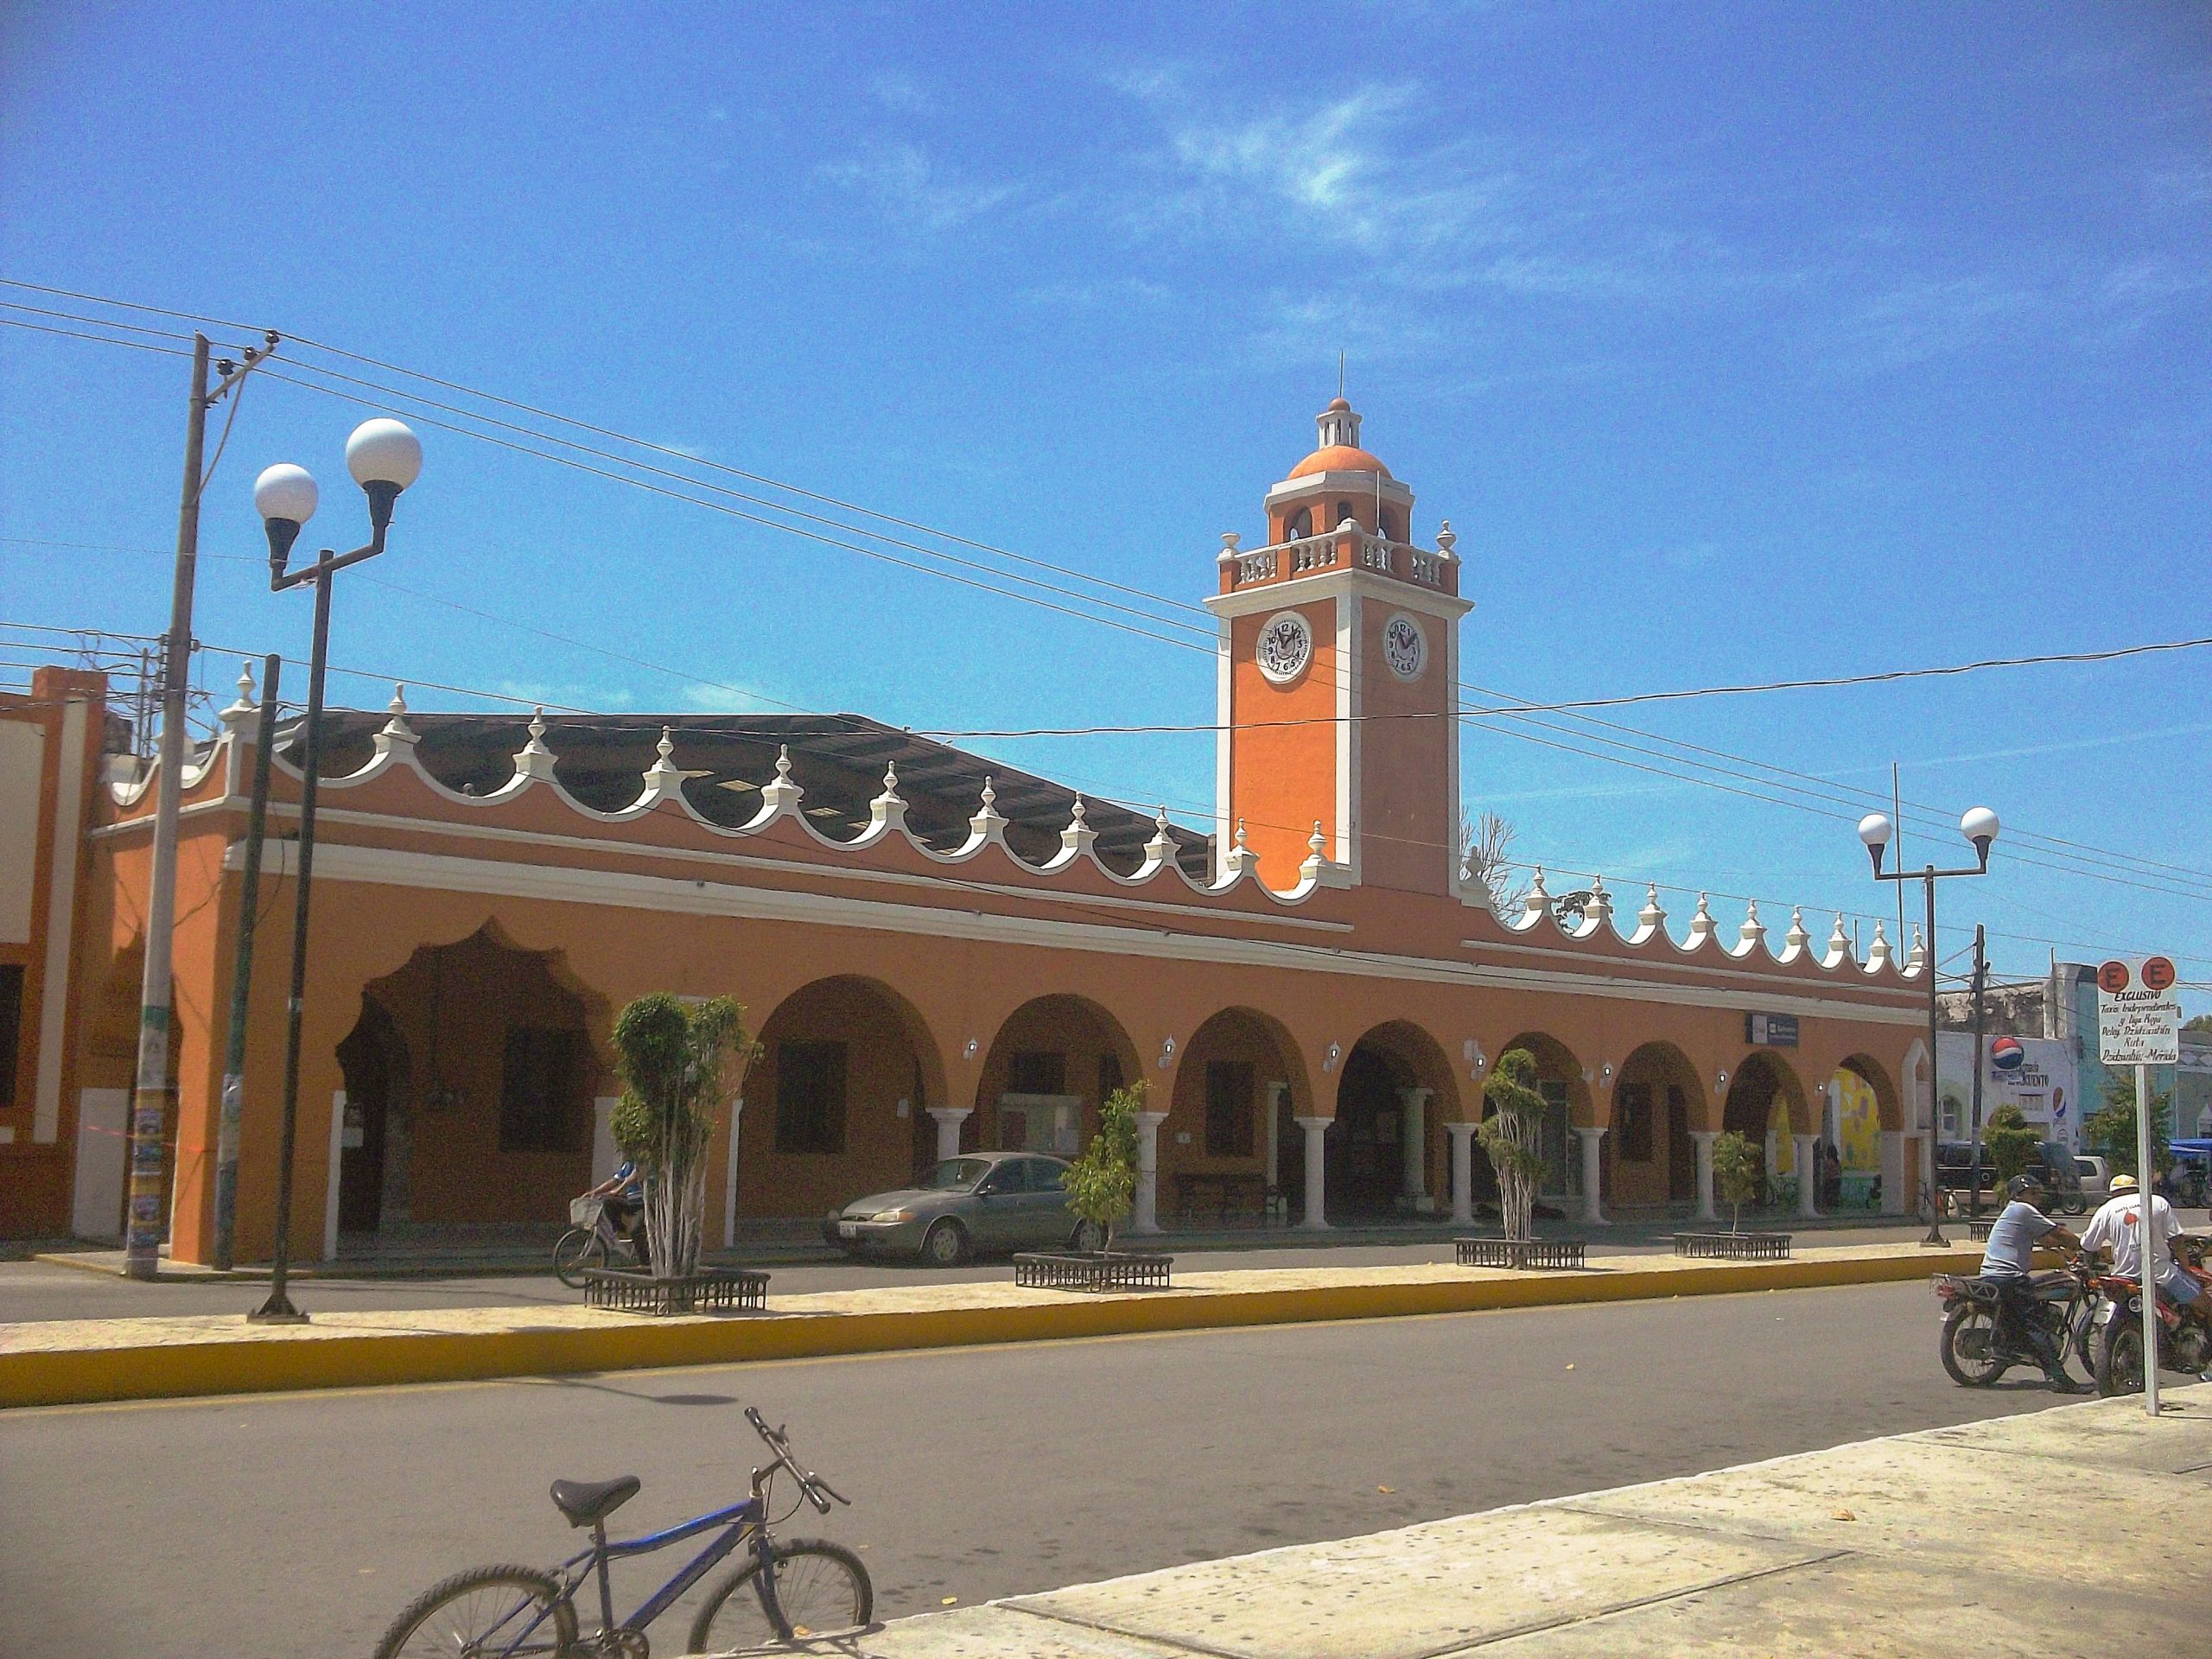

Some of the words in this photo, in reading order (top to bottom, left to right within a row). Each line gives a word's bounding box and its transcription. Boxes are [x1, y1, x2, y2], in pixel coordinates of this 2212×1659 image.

[1281, 623, 1289, 632] 12
[1297, 630, 1301, 638] 2
[1268, 637, 1276, 645] 10
[1298, 640, 1303, 648] 3
[1276, 662, 1281, 671] 7
[1290, 659, 1296, 667] 5
[2106, 967, 2120, 988] E
[2150, 964, 2165, 984] E
[2114, 991, 2161, 1002] EXCLUSIVO
[2101, 1004, 2119, 1014] Taxis
[2118, 1017, 2125, 1027] y
[2144, 1014, 2162, 1026] Roja
[2124, 1037, 2145, 1047] Ruta
